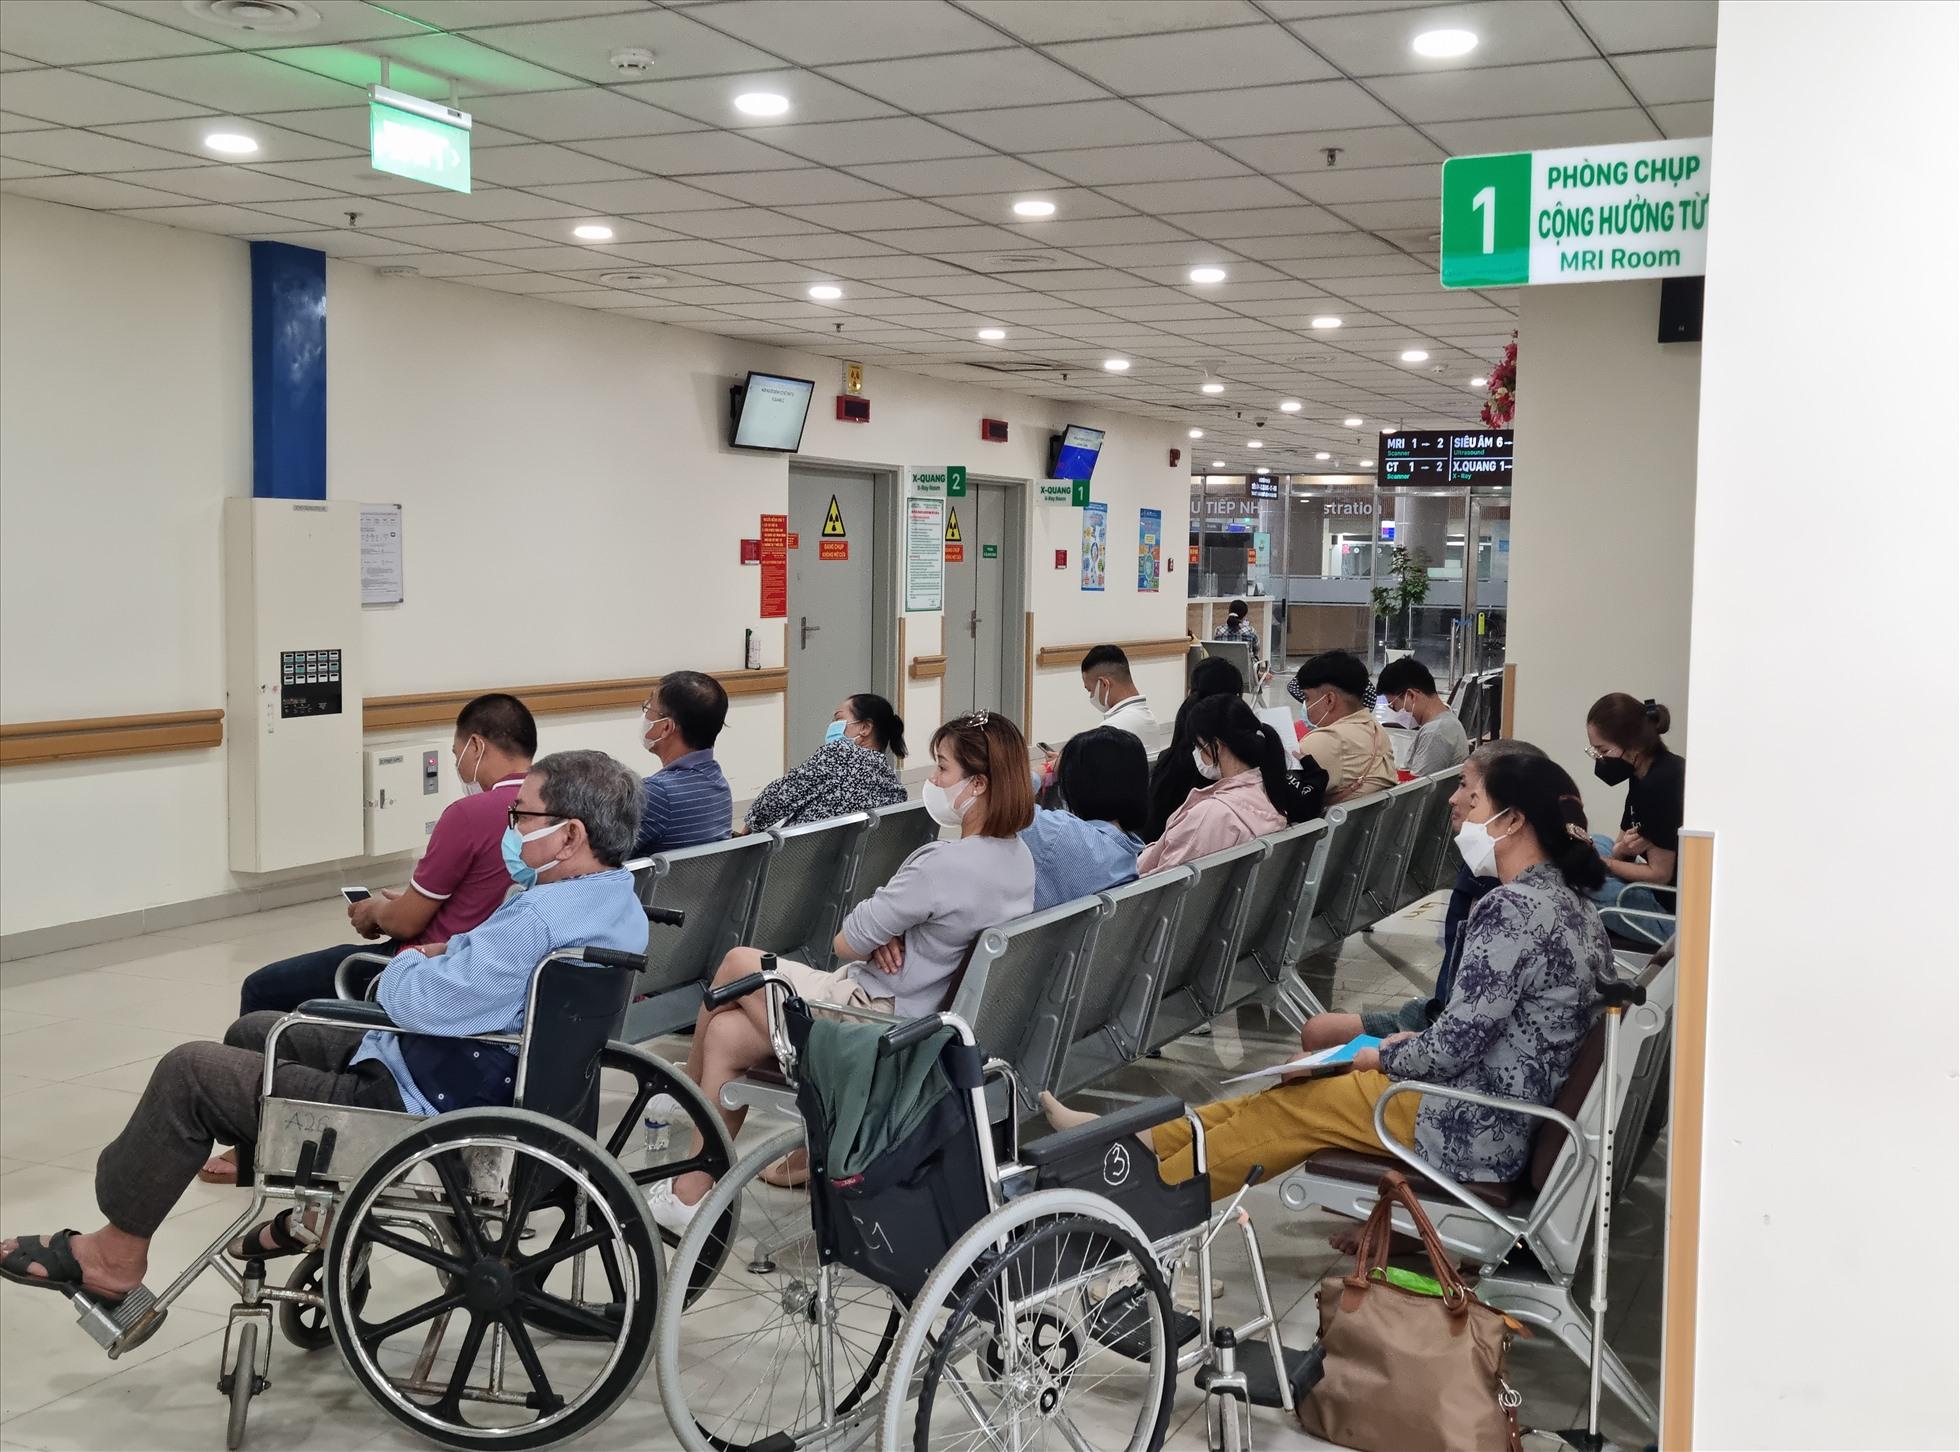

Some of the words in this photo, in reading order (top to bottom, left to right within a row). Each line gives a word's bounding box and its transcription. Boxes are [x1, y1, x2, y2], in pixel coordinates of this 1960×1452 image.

[1547, 158, 1629, 190] PHÒNG
[1634, 155, 1701, 188] CHỤP
[1472, 186, 1496, 254] 1
[1538, 201, 1595, 247] CỘNG
[1599, 193, 1675, 236] HƯỞNG
[1679, 191, 1709, 230] TỪ
[1560, 250, 1604, 272] MRI
[1611, 248, 1681, 269] Room
[1387, 438, 1405, 449] MRI
[1411, 438, 1417, 448] 1
[1437, 437, 1444, 449] 2
[1454, 435, 1476, 448] SIÊU
[1477, 434, 1493, 447] ÂM
[1386, 462, 1399, 472] CT
[1409, 462, 1415, 472] 1
[1436, 462, 1443, 472] 2
[1452, 461, 1497, 473] X.QUANG
[912, 473, 946, 484] X-QUANG
[952, 473, 961, 490] 2
[1040, 486, 1071, 495] X-QUANG
[1078, 486, 1084, 501] 1
[1206, 497, 1236, 514] TIẾP
